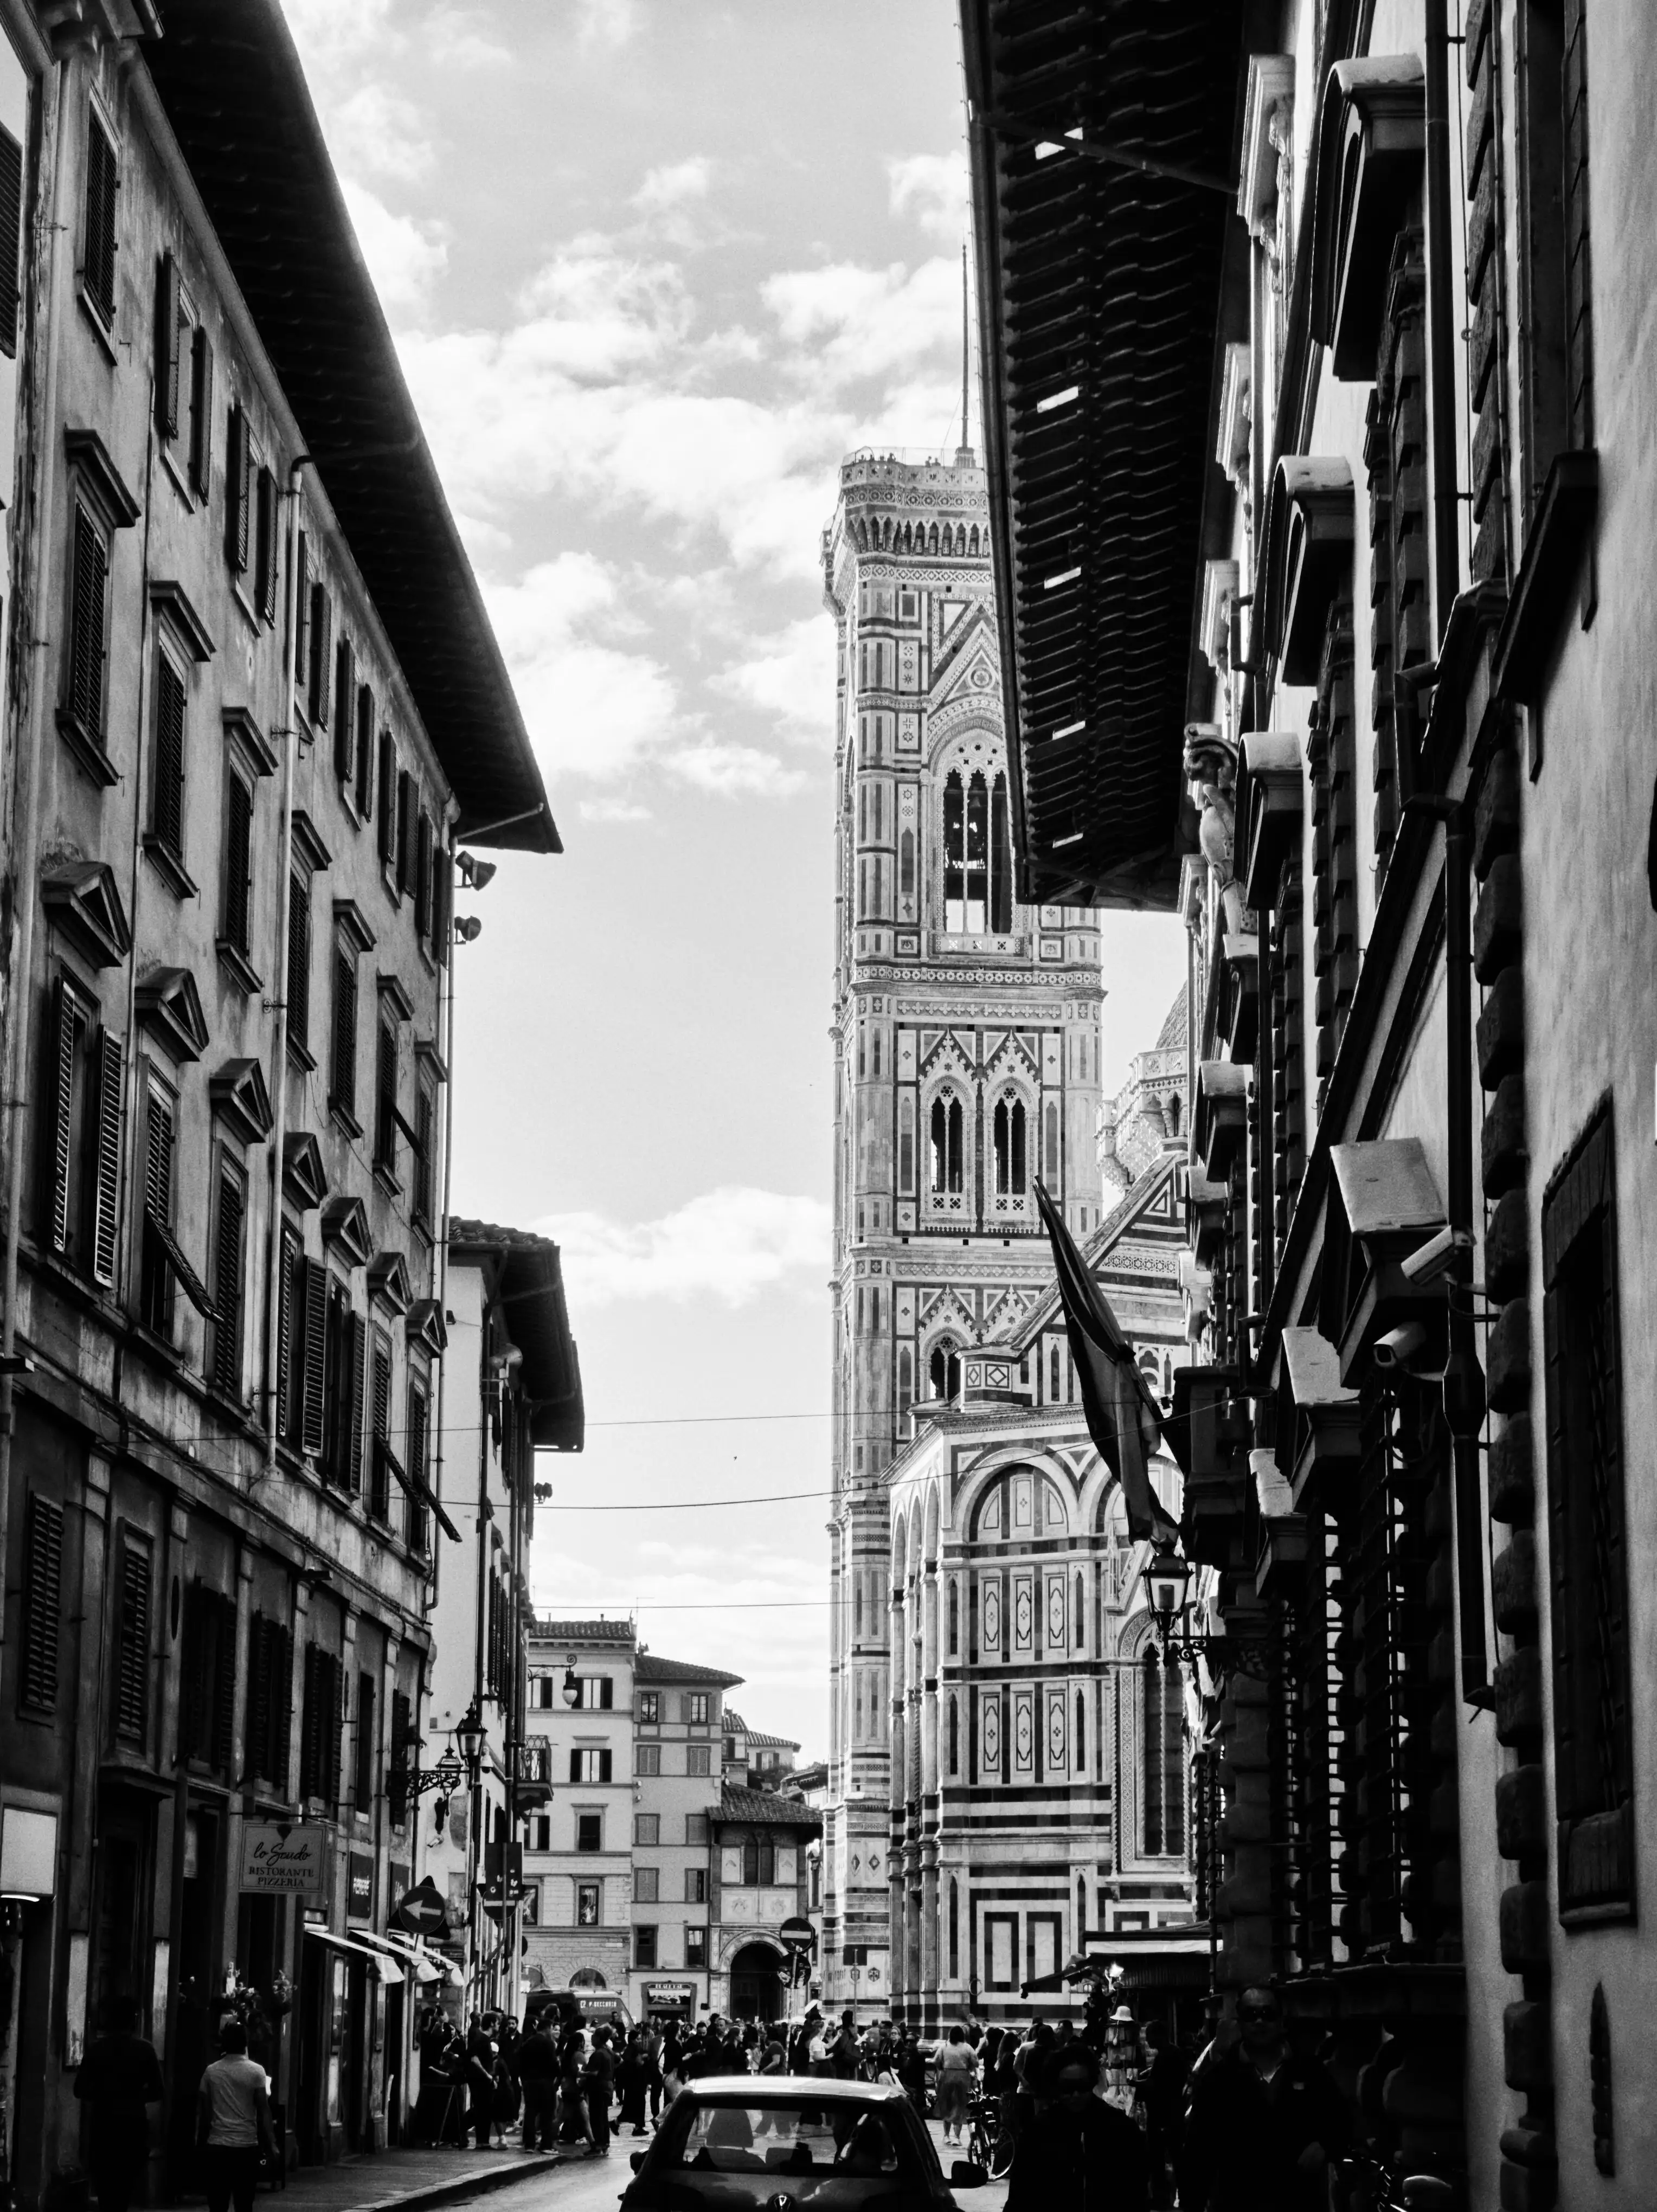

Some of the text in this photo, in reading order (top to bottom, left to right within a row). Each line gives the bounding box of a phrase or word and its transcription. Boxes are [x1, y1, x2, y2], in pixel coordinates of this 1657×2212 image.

[266, 1843, 312, 1867] Scudo
[249, 1866, 314, 1877] RISTORANTE
[258, 1877, 304, 1887] PIZZERIA
